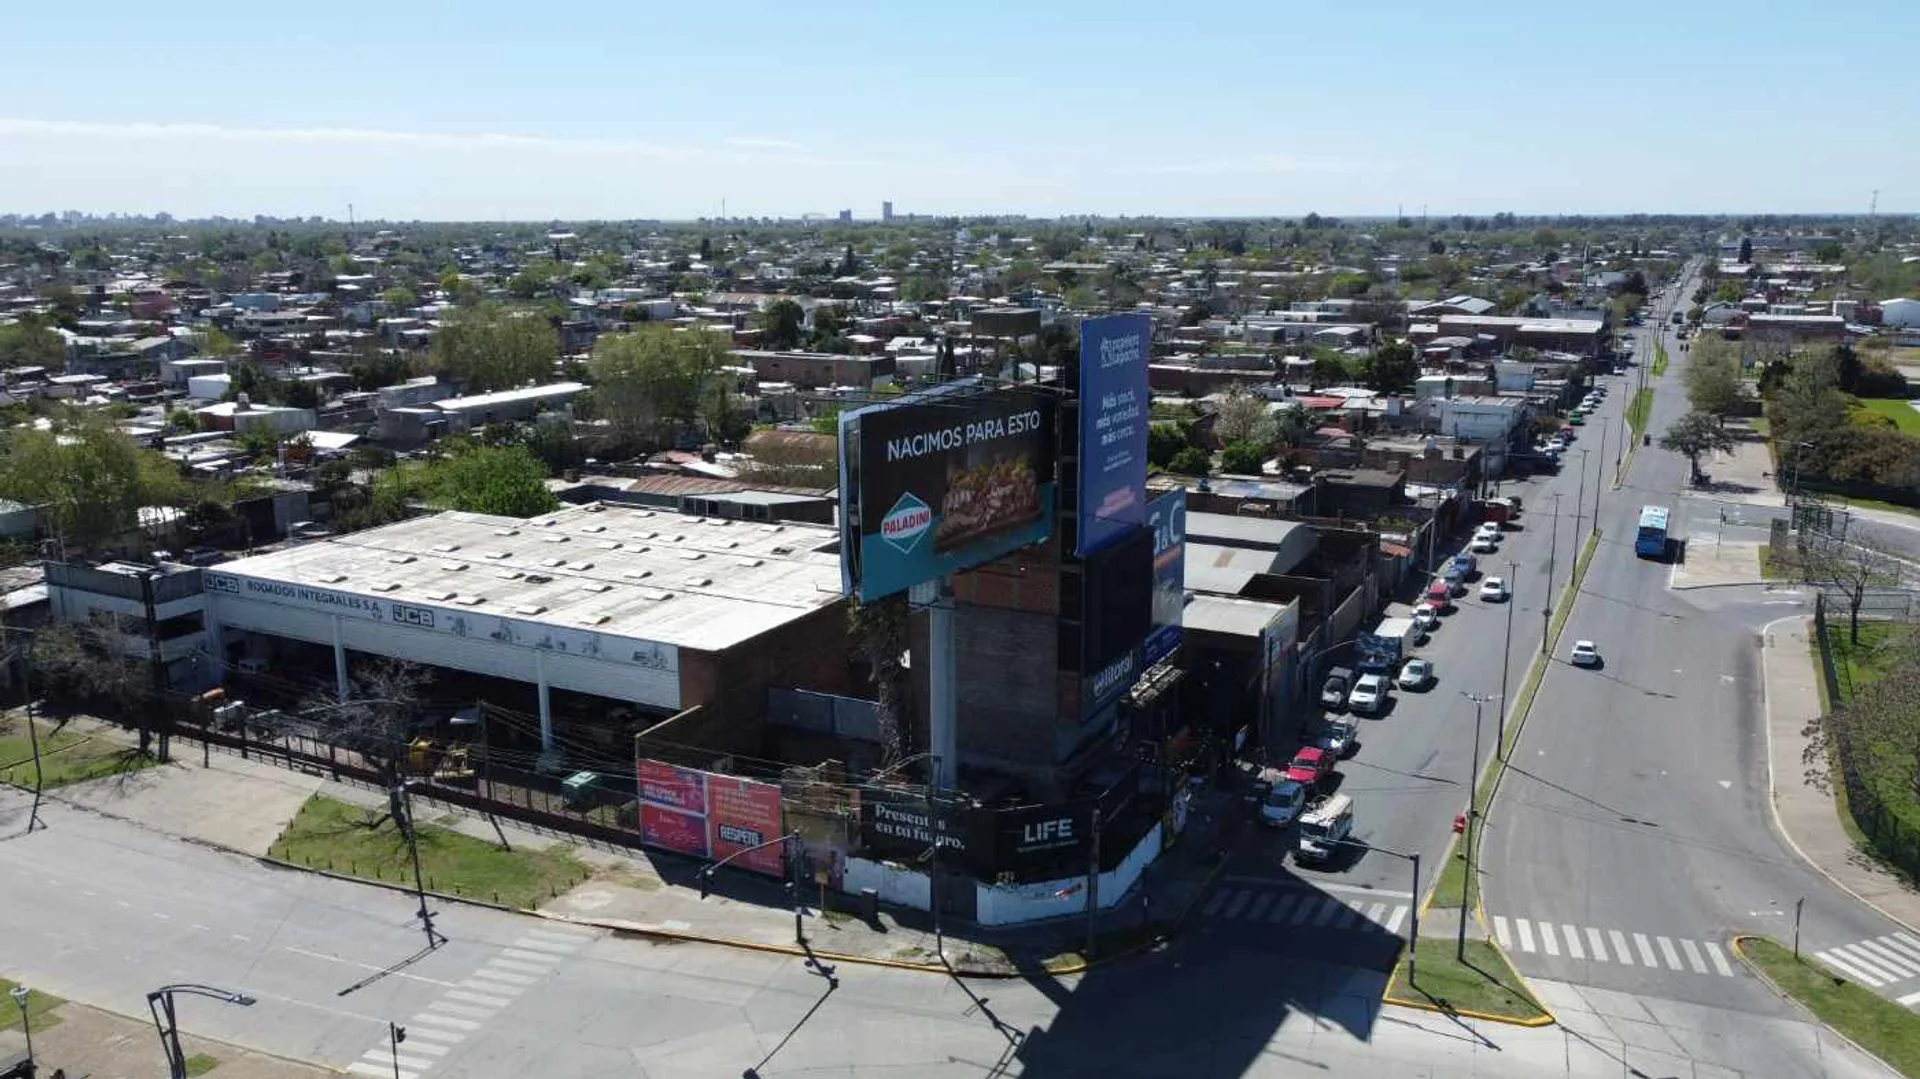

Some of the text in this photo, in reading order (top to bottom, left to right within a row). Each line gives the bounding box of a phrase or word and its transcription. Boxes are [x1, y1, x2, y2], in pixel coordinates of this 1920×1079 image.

[887, 410, 1041, 462] NACIMOS PARA ESTO
[883, 508, 930, 535] PALADINI
[297, 586, 361, 609] INTEGRALES
[393, 604, 434, 627] JCB
[875, 821, 893, 834] en
[1024, 818, 1074, 843] LIFE
